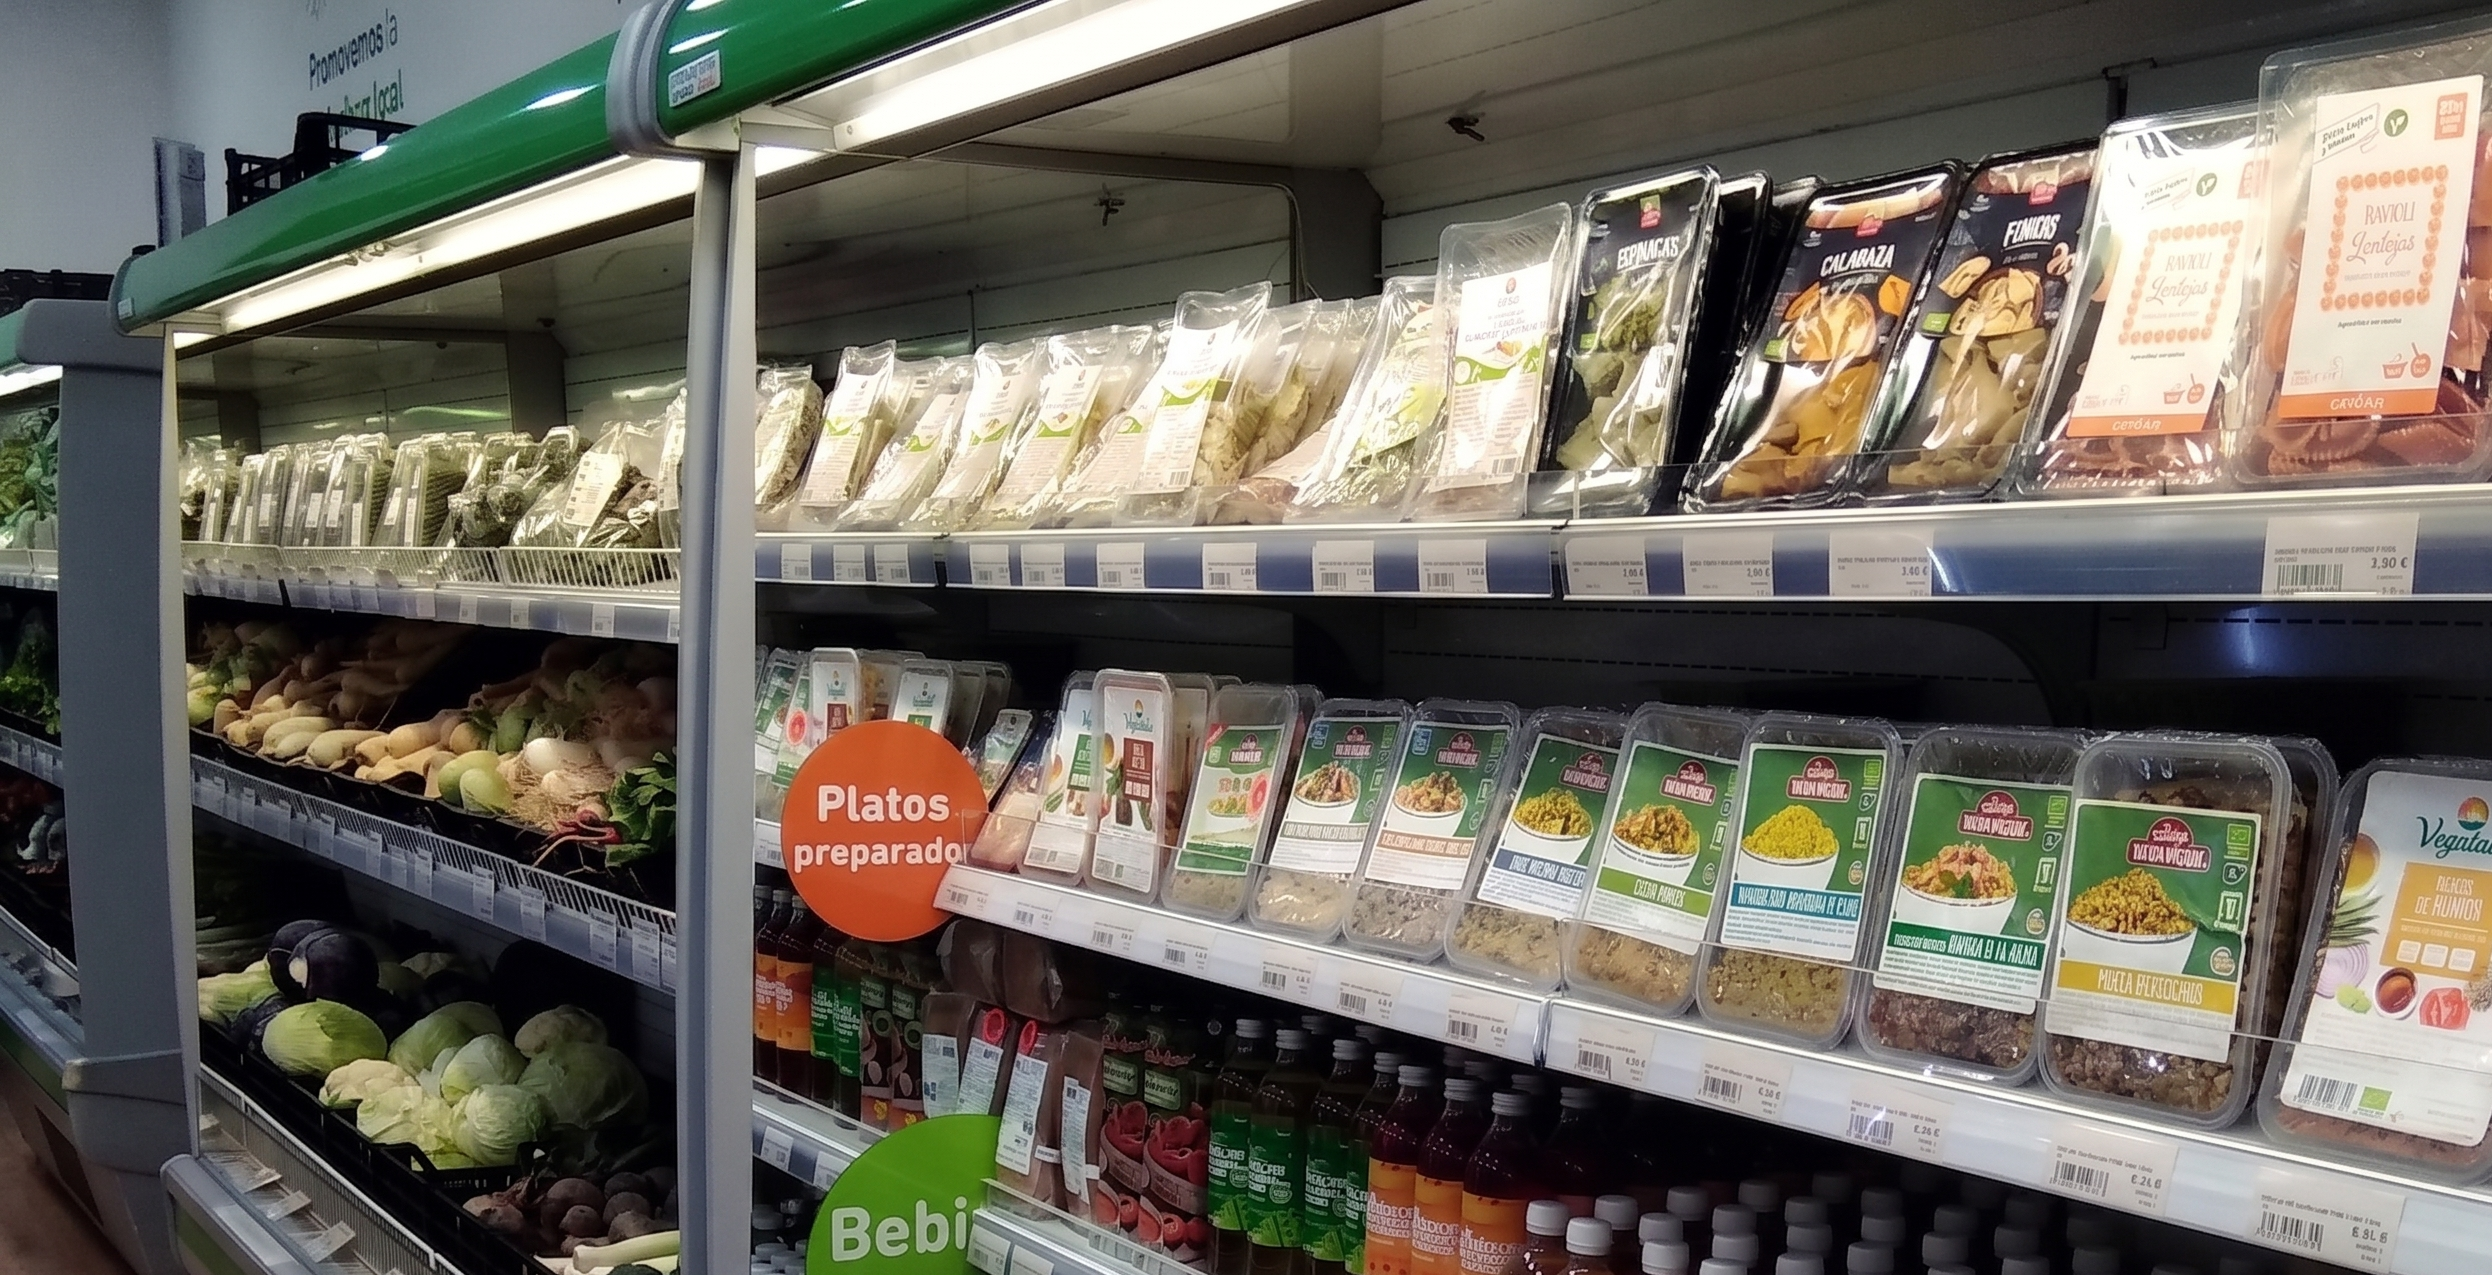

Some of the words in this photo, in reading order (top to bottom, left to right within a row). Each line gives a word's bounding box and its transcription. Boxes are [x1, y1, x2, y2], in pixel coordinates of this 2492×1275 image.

[309, 23, 384, 91] Promovemos
[385, 8, 398, 49] la
[373, 68, 404, 120] local
[2365, 201, 2415, 226] RAVIOLI
[1820, 243, 1895, 277] CALABAZA
[2165, 252, 2212, 272] RAVIOLI
[2347, 231, 2415, 266] Lentejas
[2146, 275, 2208, 307] Lentejas
[2401, 556, 2408, 568] €
[817, 784, 951, 823] Platos
[793, 836, 965, 874] preparado
[831, 1196, 968, 1263] Bebi
